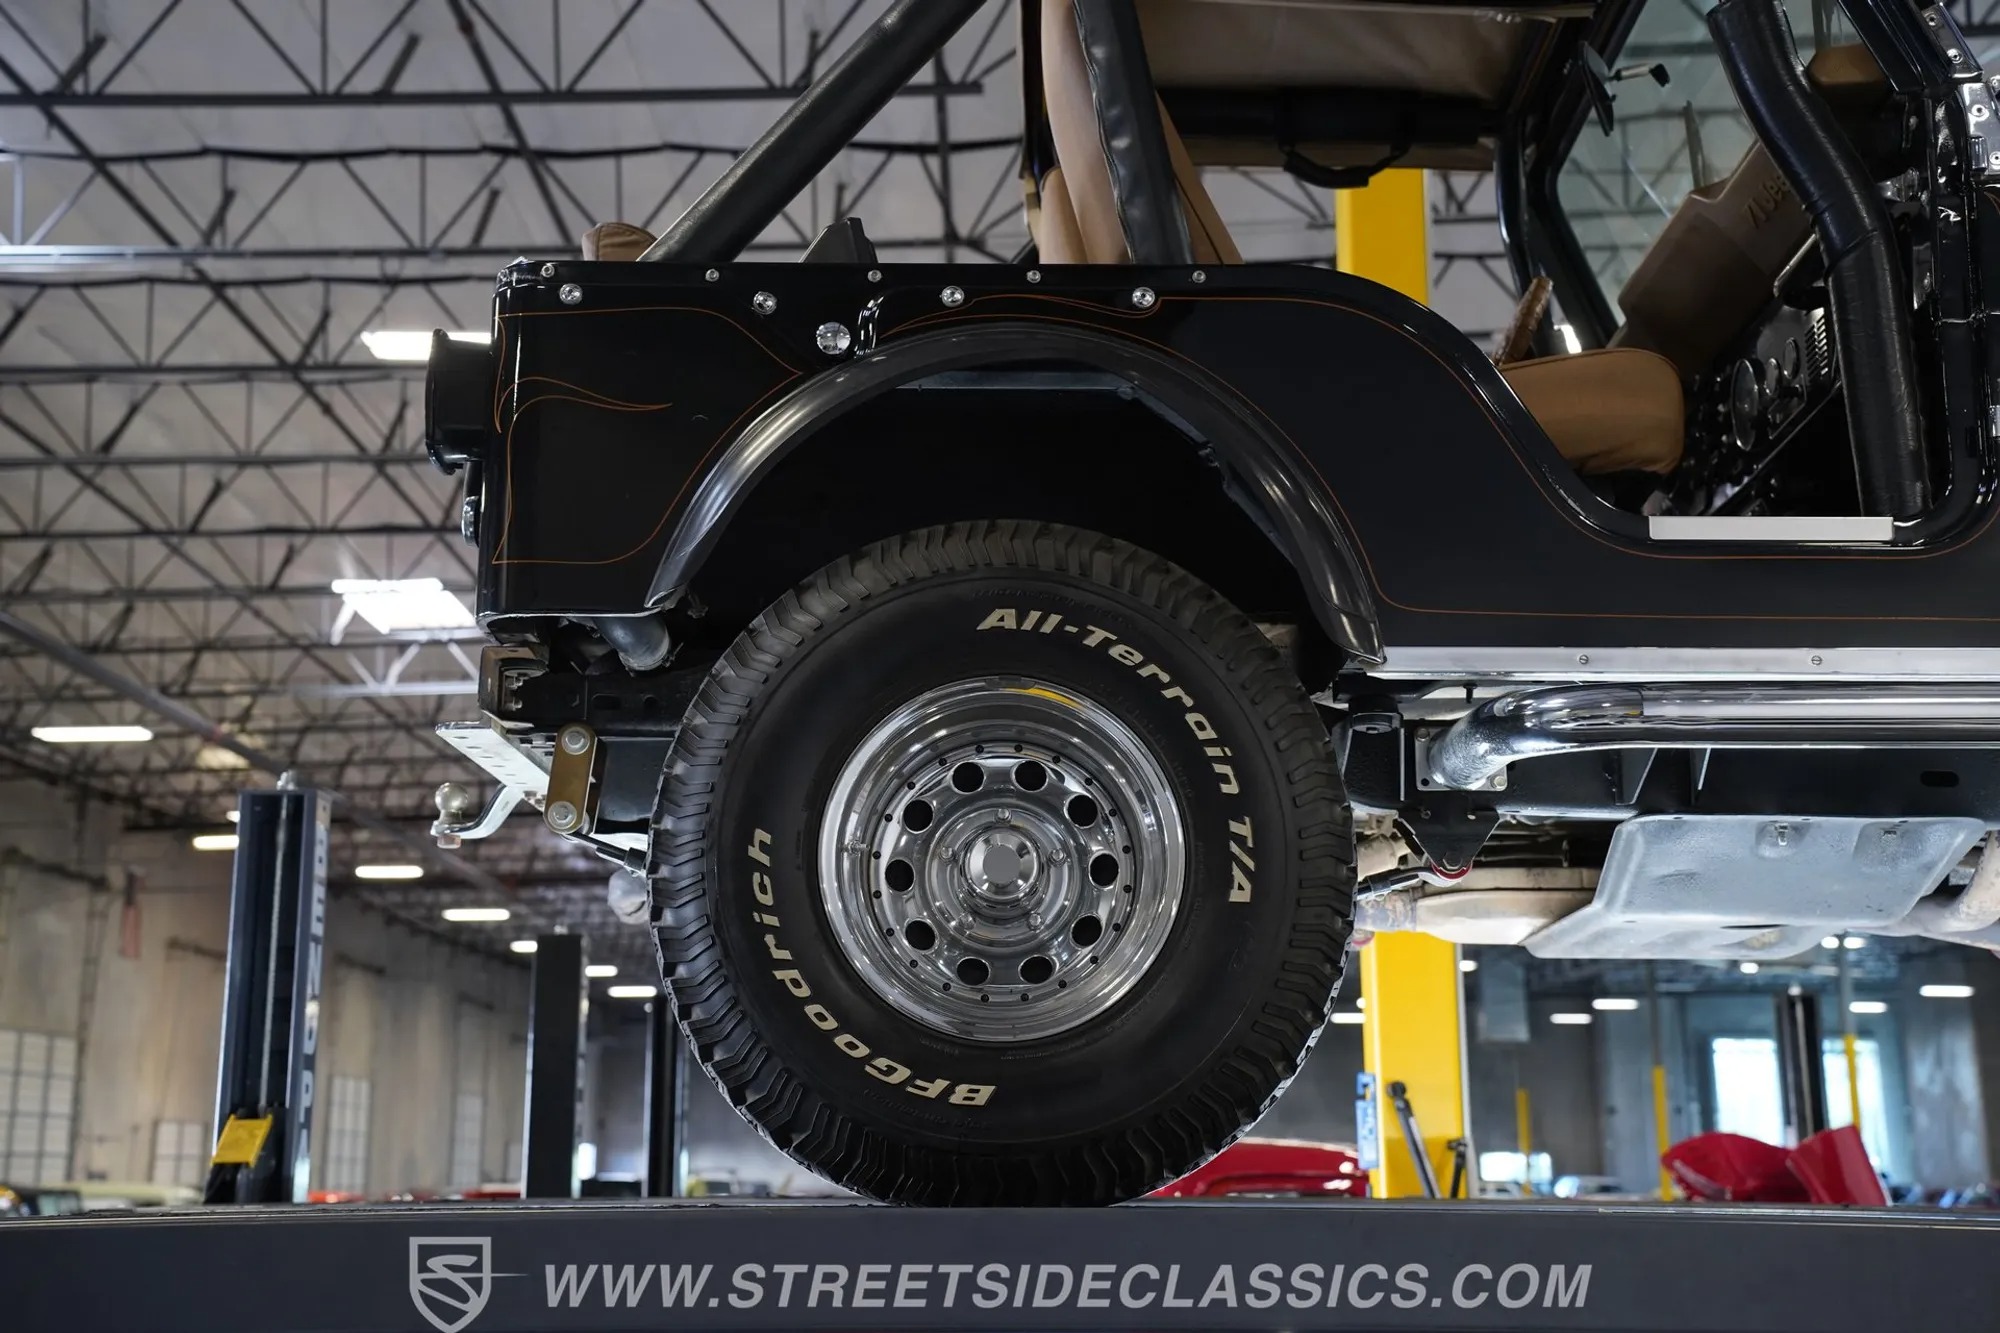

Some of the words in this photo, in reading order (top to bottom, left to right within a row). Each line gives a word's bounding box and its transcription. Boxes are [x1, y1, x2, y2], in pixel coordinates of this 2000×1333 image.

[976, 608, 1240, 795] All-Terrain
[1228, 816, 1255, 903] T/A
[747, 828, 996, 1106] BFGoodrich
